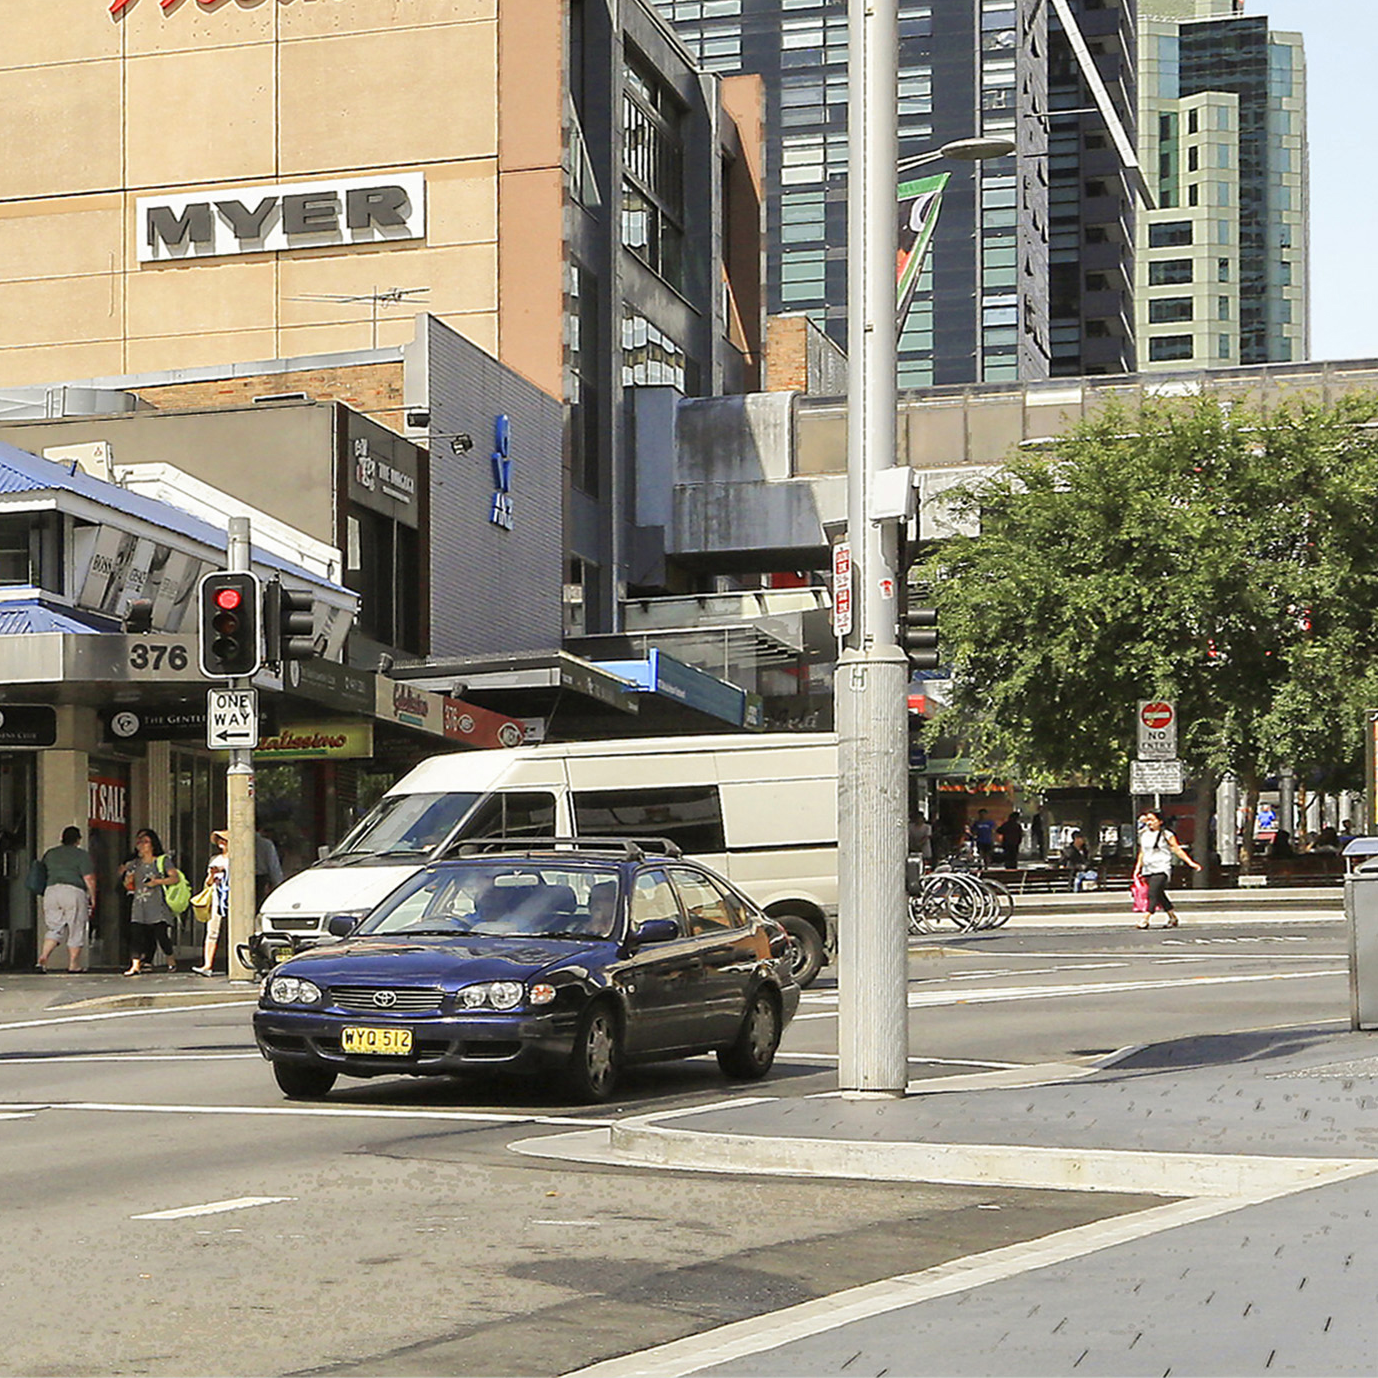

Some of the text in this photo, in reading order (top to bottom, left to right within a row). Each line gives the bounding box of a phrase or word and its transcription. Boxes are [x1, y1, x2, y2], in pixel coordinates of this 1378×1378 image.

[146, 185, 412, 251] MYER
[129, 643, 189, 671] 376
[216, 695, 249, 709] ONE
[214, 713, 250, 727] WAY
[1148, 731, 1167, 740] NO
[1142, 741, 1173, 750] ENTRY
[99, 783, 126, 824] SALE
[382, 1031, 410, 1047] 512
